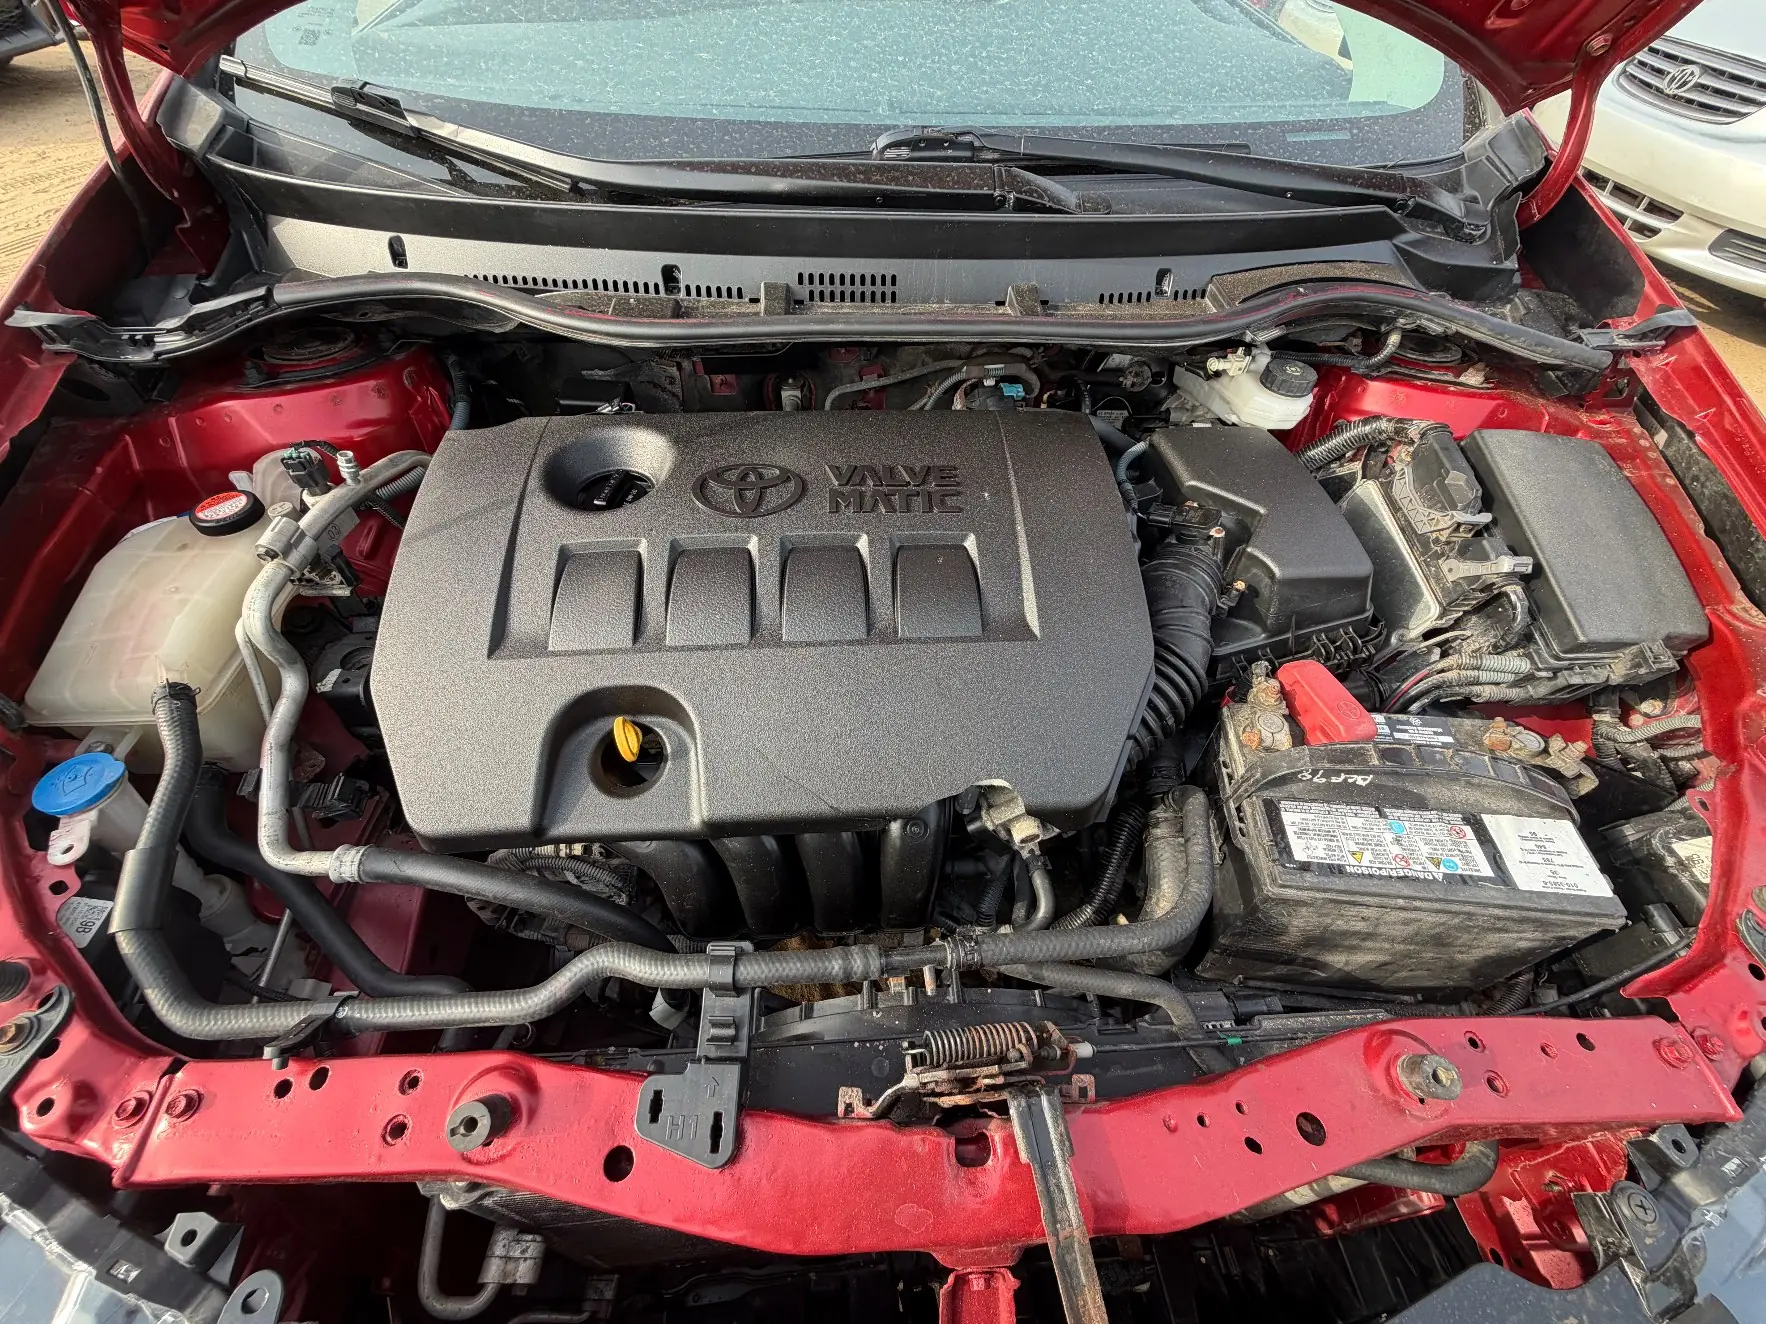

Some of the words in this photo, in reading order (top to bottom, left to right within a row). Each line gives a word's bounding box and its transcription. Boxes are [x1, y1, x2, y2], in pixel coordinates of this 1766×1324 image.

[825, 464, 960, 487] VALVE
[828, 488, 964, 514] MATIC
[665, 1115, 699, 1140] H1
